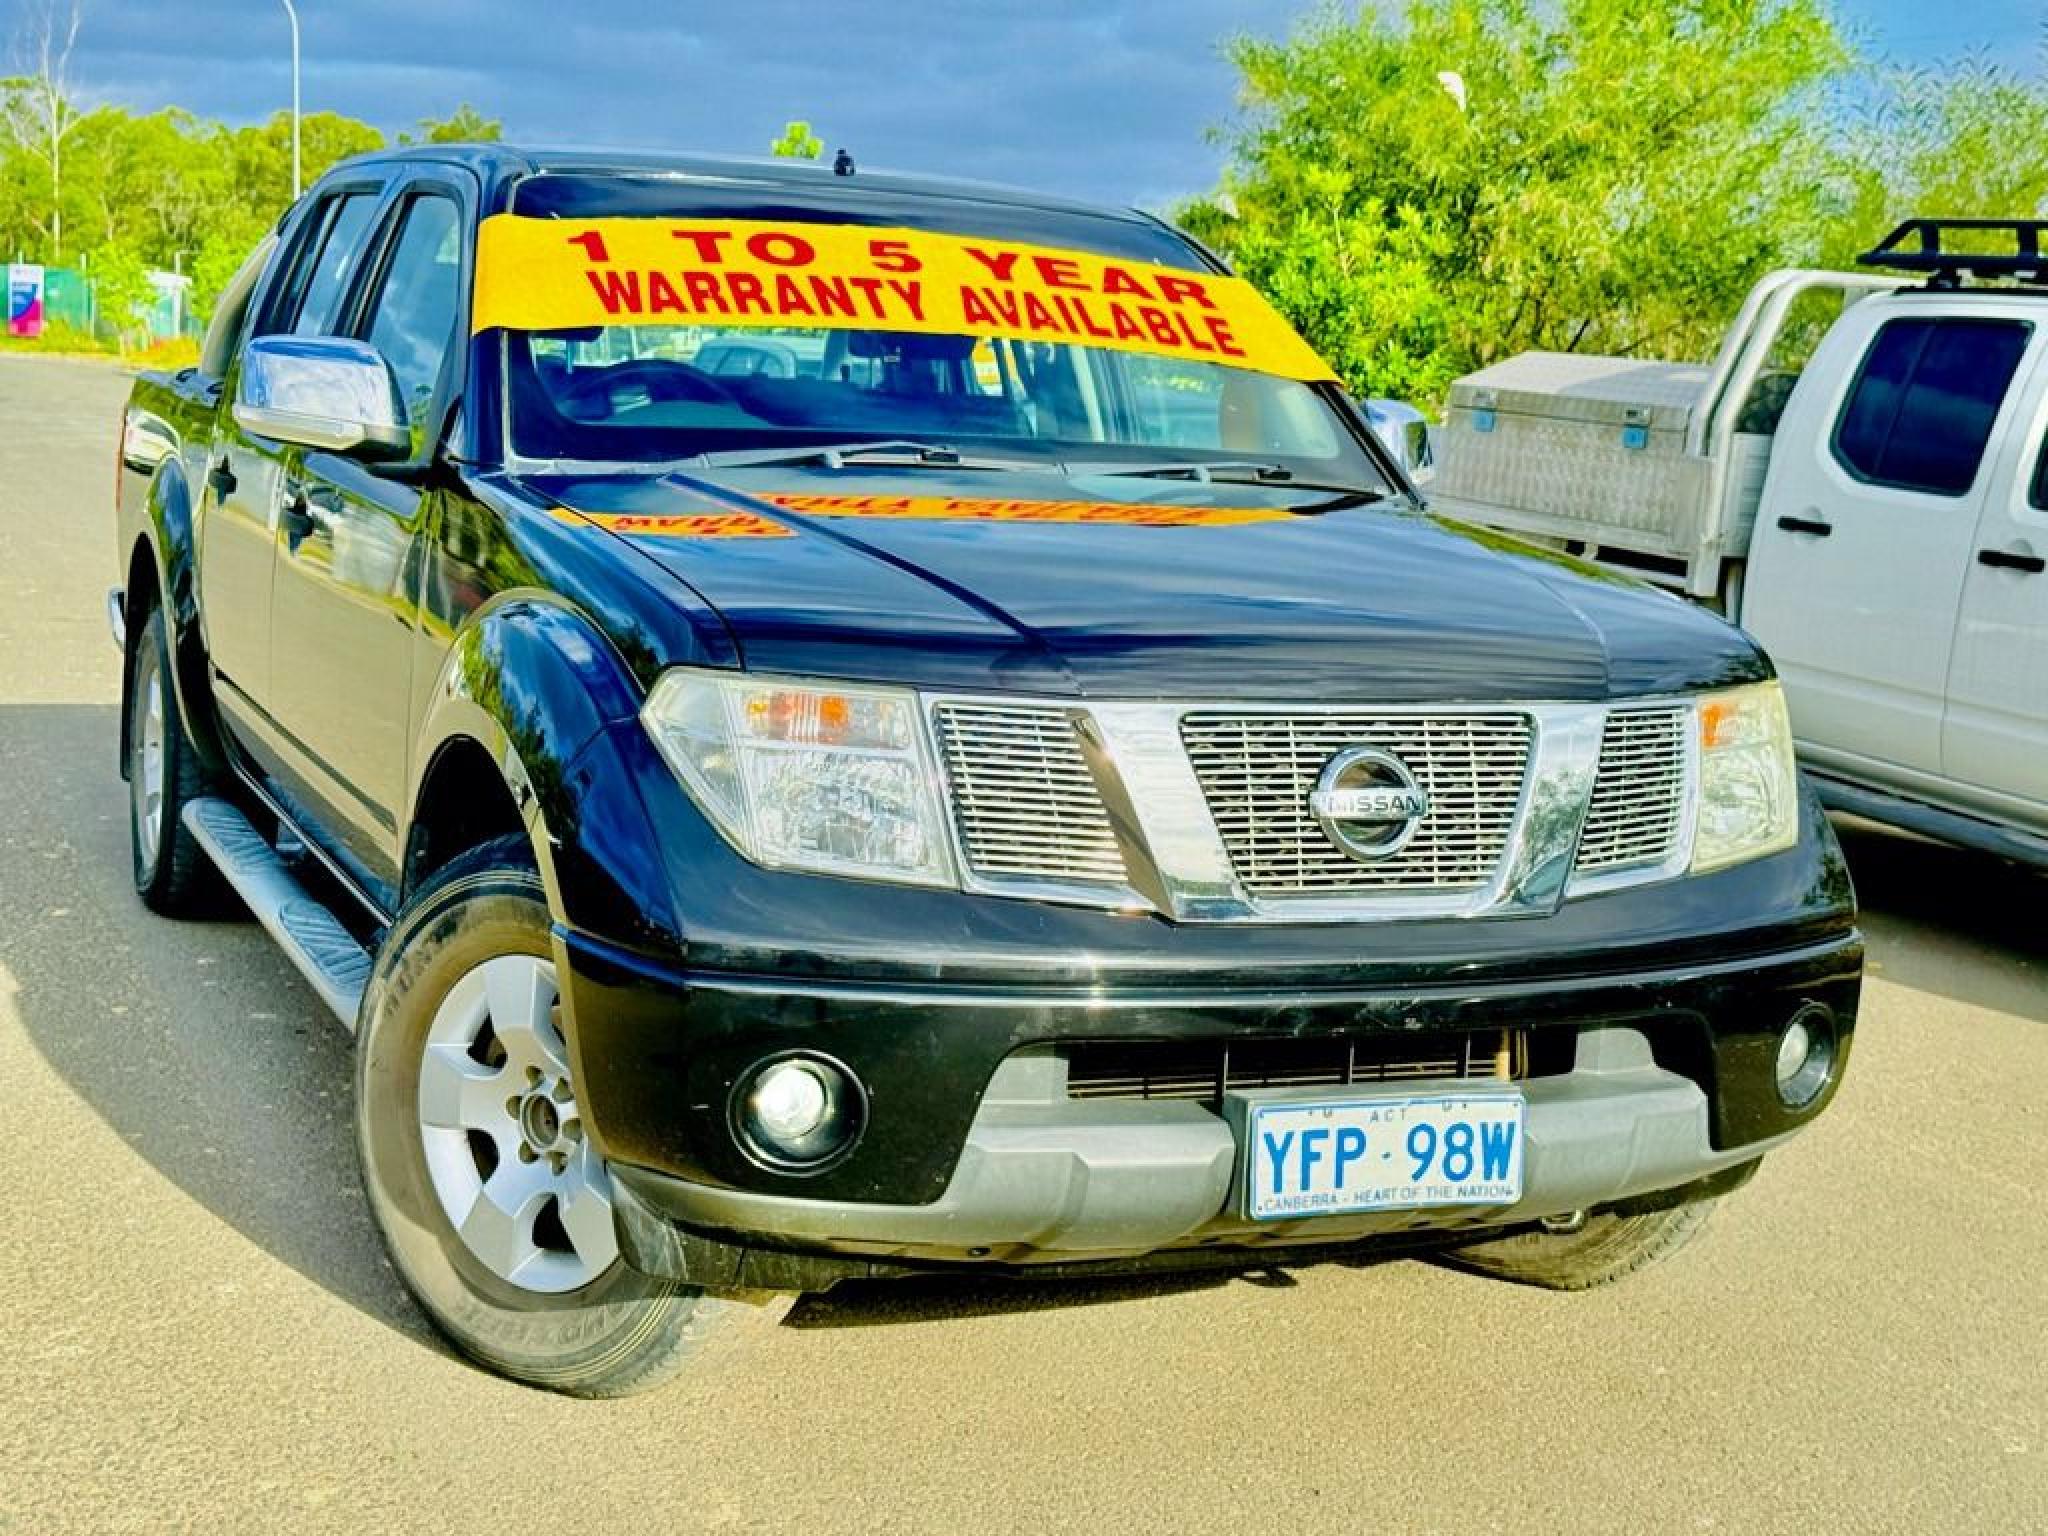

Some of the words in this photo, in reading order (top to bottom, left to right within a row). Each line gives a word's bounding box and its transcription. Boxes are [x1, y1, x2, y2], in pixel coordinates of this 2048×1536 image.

[567, 230, 609, 263] 1
[671, 230, 815, 267] TO
[868, 239, 923, 274] 5
[961, 246, 1218, 309] YEAR
[585, 271, 925, 321] WARRANTY
[959, 285, 1247, 357] AVAILABLE
[1327, 795, 1421, 812] NISSAN
[1263, 1127, 1367, 1194] YFP
[1406, 1121, 1516, 1182] 98W
[1263, 1194, 1338, 1210] CANBERRA
[1353, 1188, 1397, 1203] HEART
[1399, 1187, 1417, 1200] OF
[1427, 1185, 1451, 1198] THE
